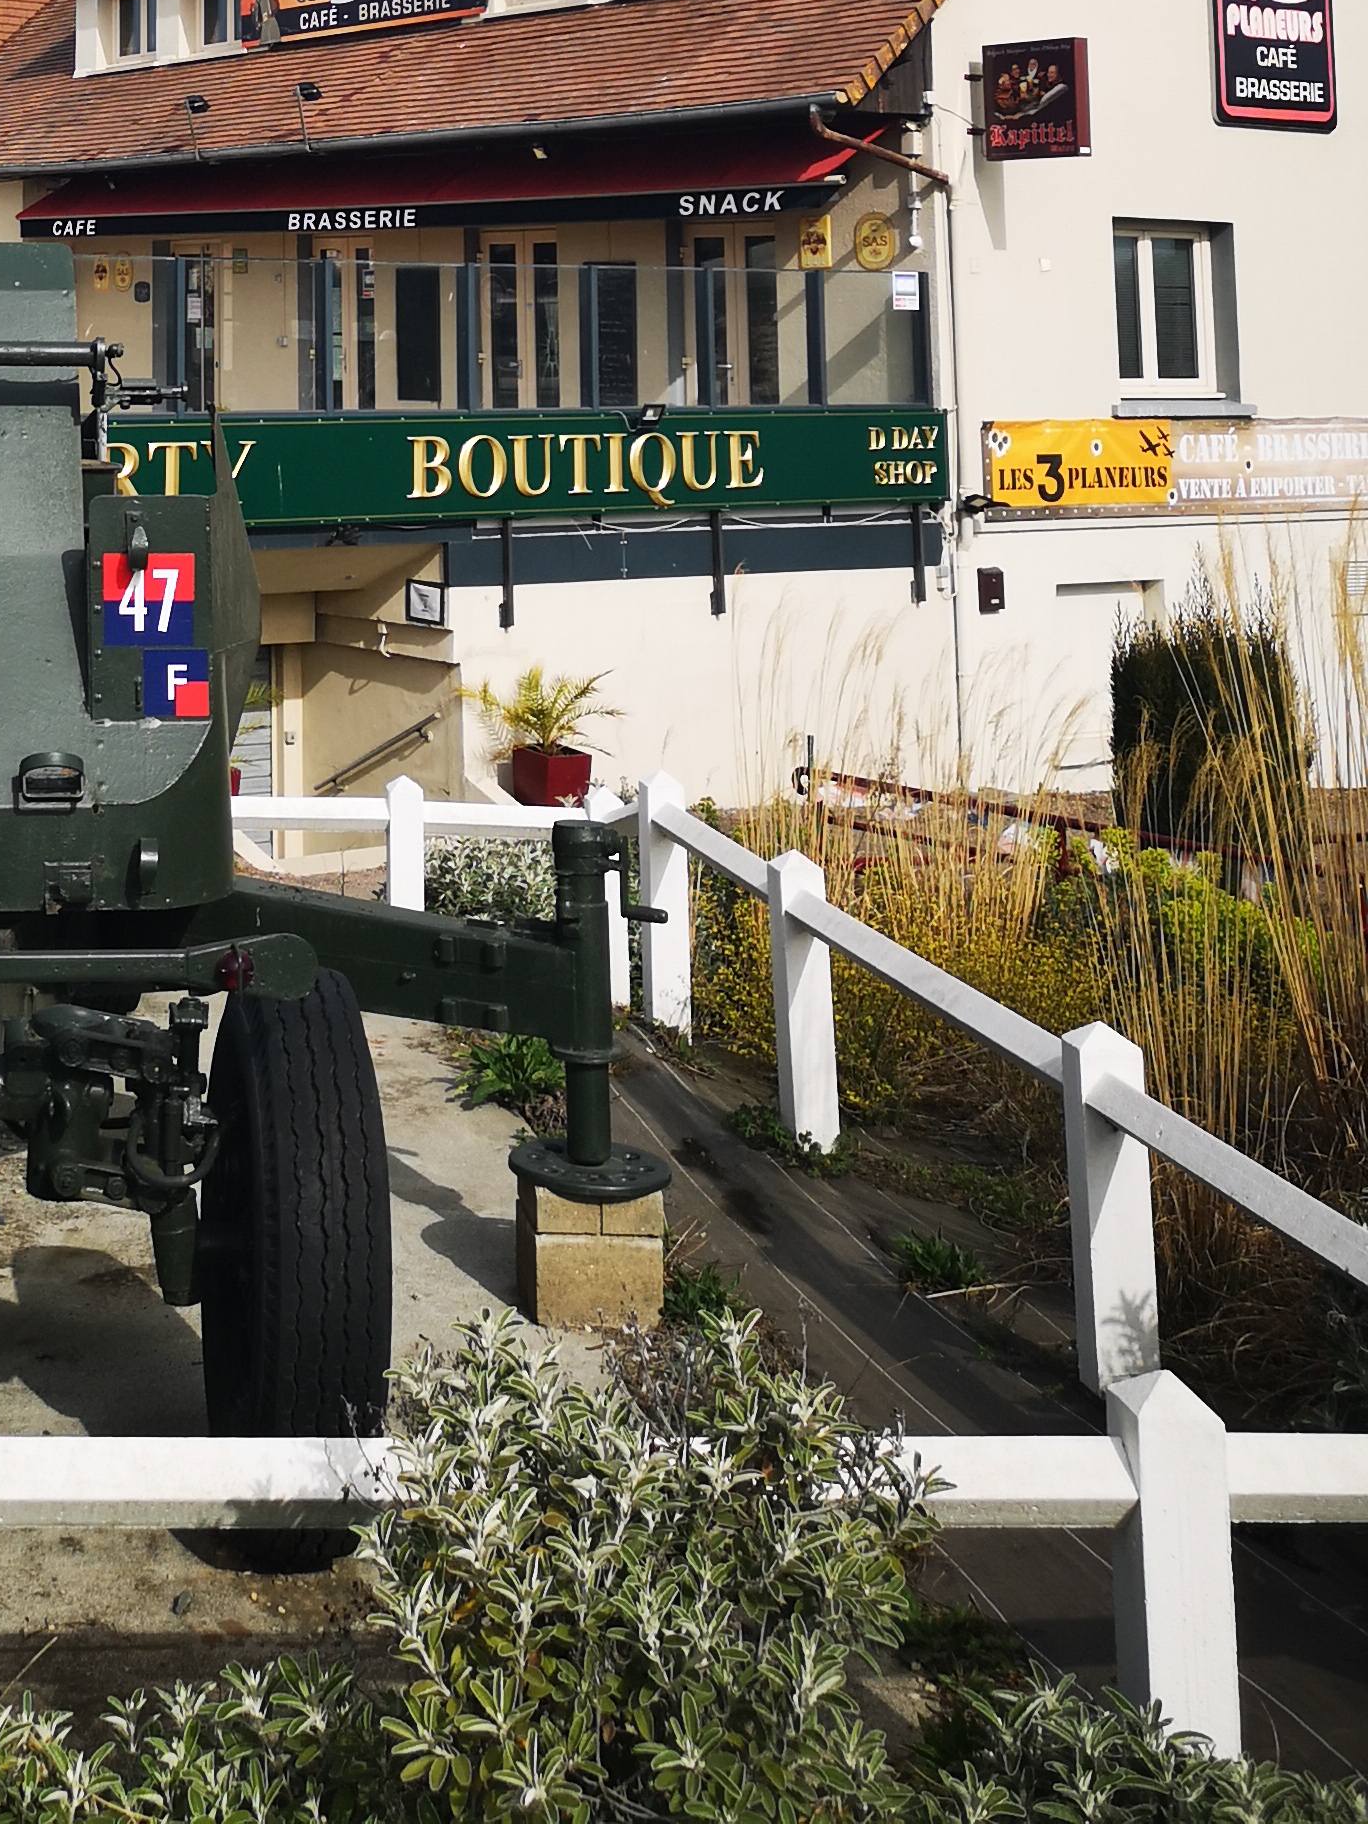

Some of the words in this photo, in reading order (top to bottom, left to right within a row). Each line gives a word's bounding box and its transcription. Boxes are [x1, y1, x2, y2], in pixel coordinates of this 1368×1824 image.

[299, 4, 338, 30] CAFÉ
[1226, 3, 1324, 44] PLANEURS
[1256, 44, 1297, 69] CAFÉ
[1235, 76, 1325, 103] BRASSERIE
[52, 219, 96, 236] CAFE
[287, 209, 417, 231] BRASSERIE
[678, 190, 785, 216] SNACK
[867, 426, 886, 451] D
[890, 425, 939, 450] DAY
[1178, 427, 1239, 463] CAFÉ
[406, 430, 765, 508] BOUTIQUE
[874, 460, 938, 485] SHOP
[998, 467, 1034, 491] LES
[1036, 453, 1064, 503] 3
[1067, 465, 1168, 490] PLANEURS
[1178, 478, 1232, 499] VENTE
[1235, 473, 1247, 498] À
[1250, 475, 1336, 498] EMPORTER
[118, 568, 179, 633] 47
[167, 663, 188, 701] F
